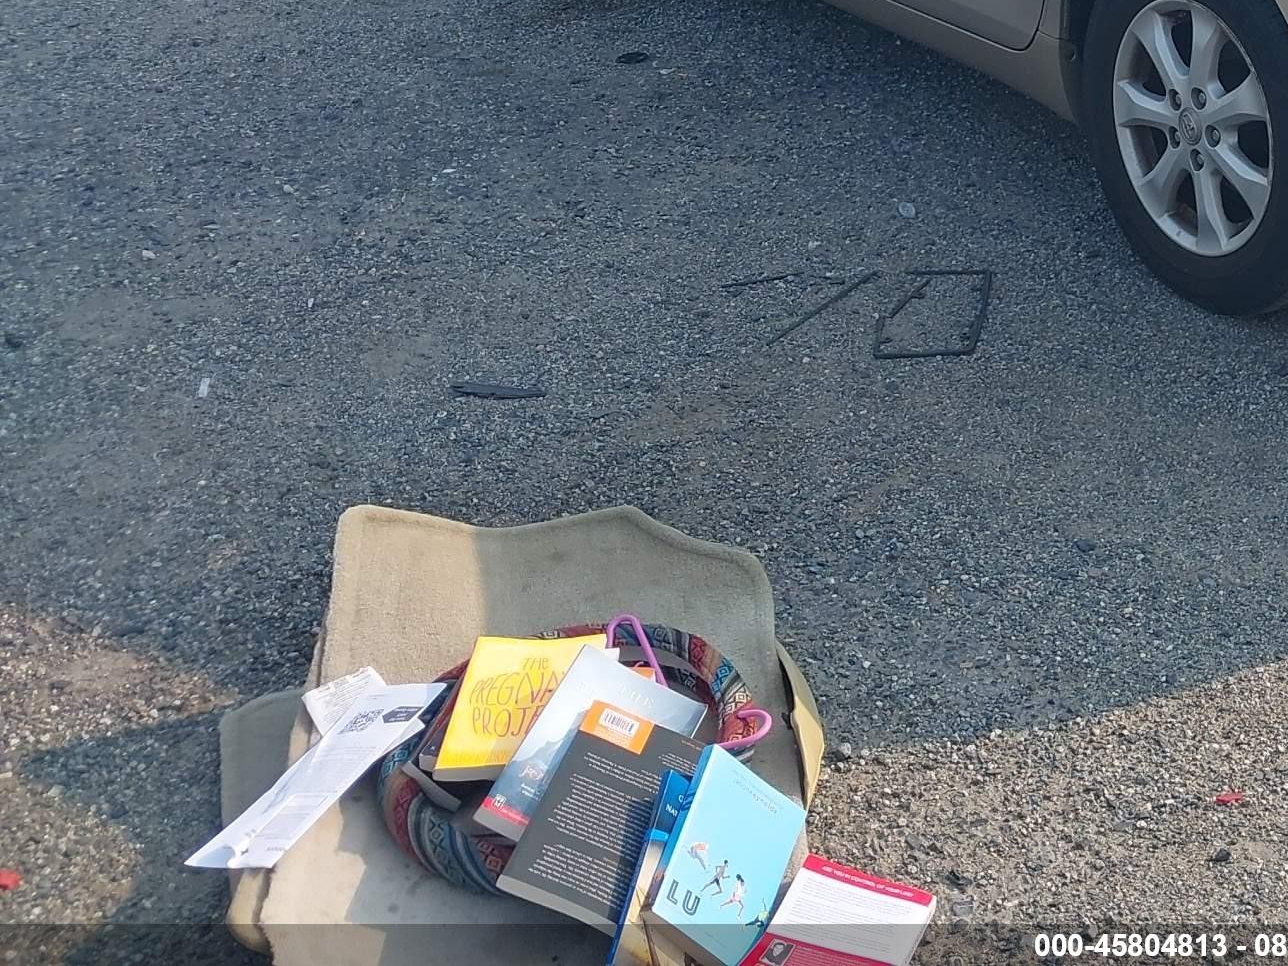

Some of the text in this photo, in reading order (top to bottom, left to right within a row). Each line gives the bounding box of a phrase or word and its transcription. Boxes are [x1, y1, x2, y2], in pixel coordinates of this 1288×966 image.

[522, 657, 550, 671] THE
[469, 670, 565, 705] PREGNA
[666, 879, 701, 916] LU
